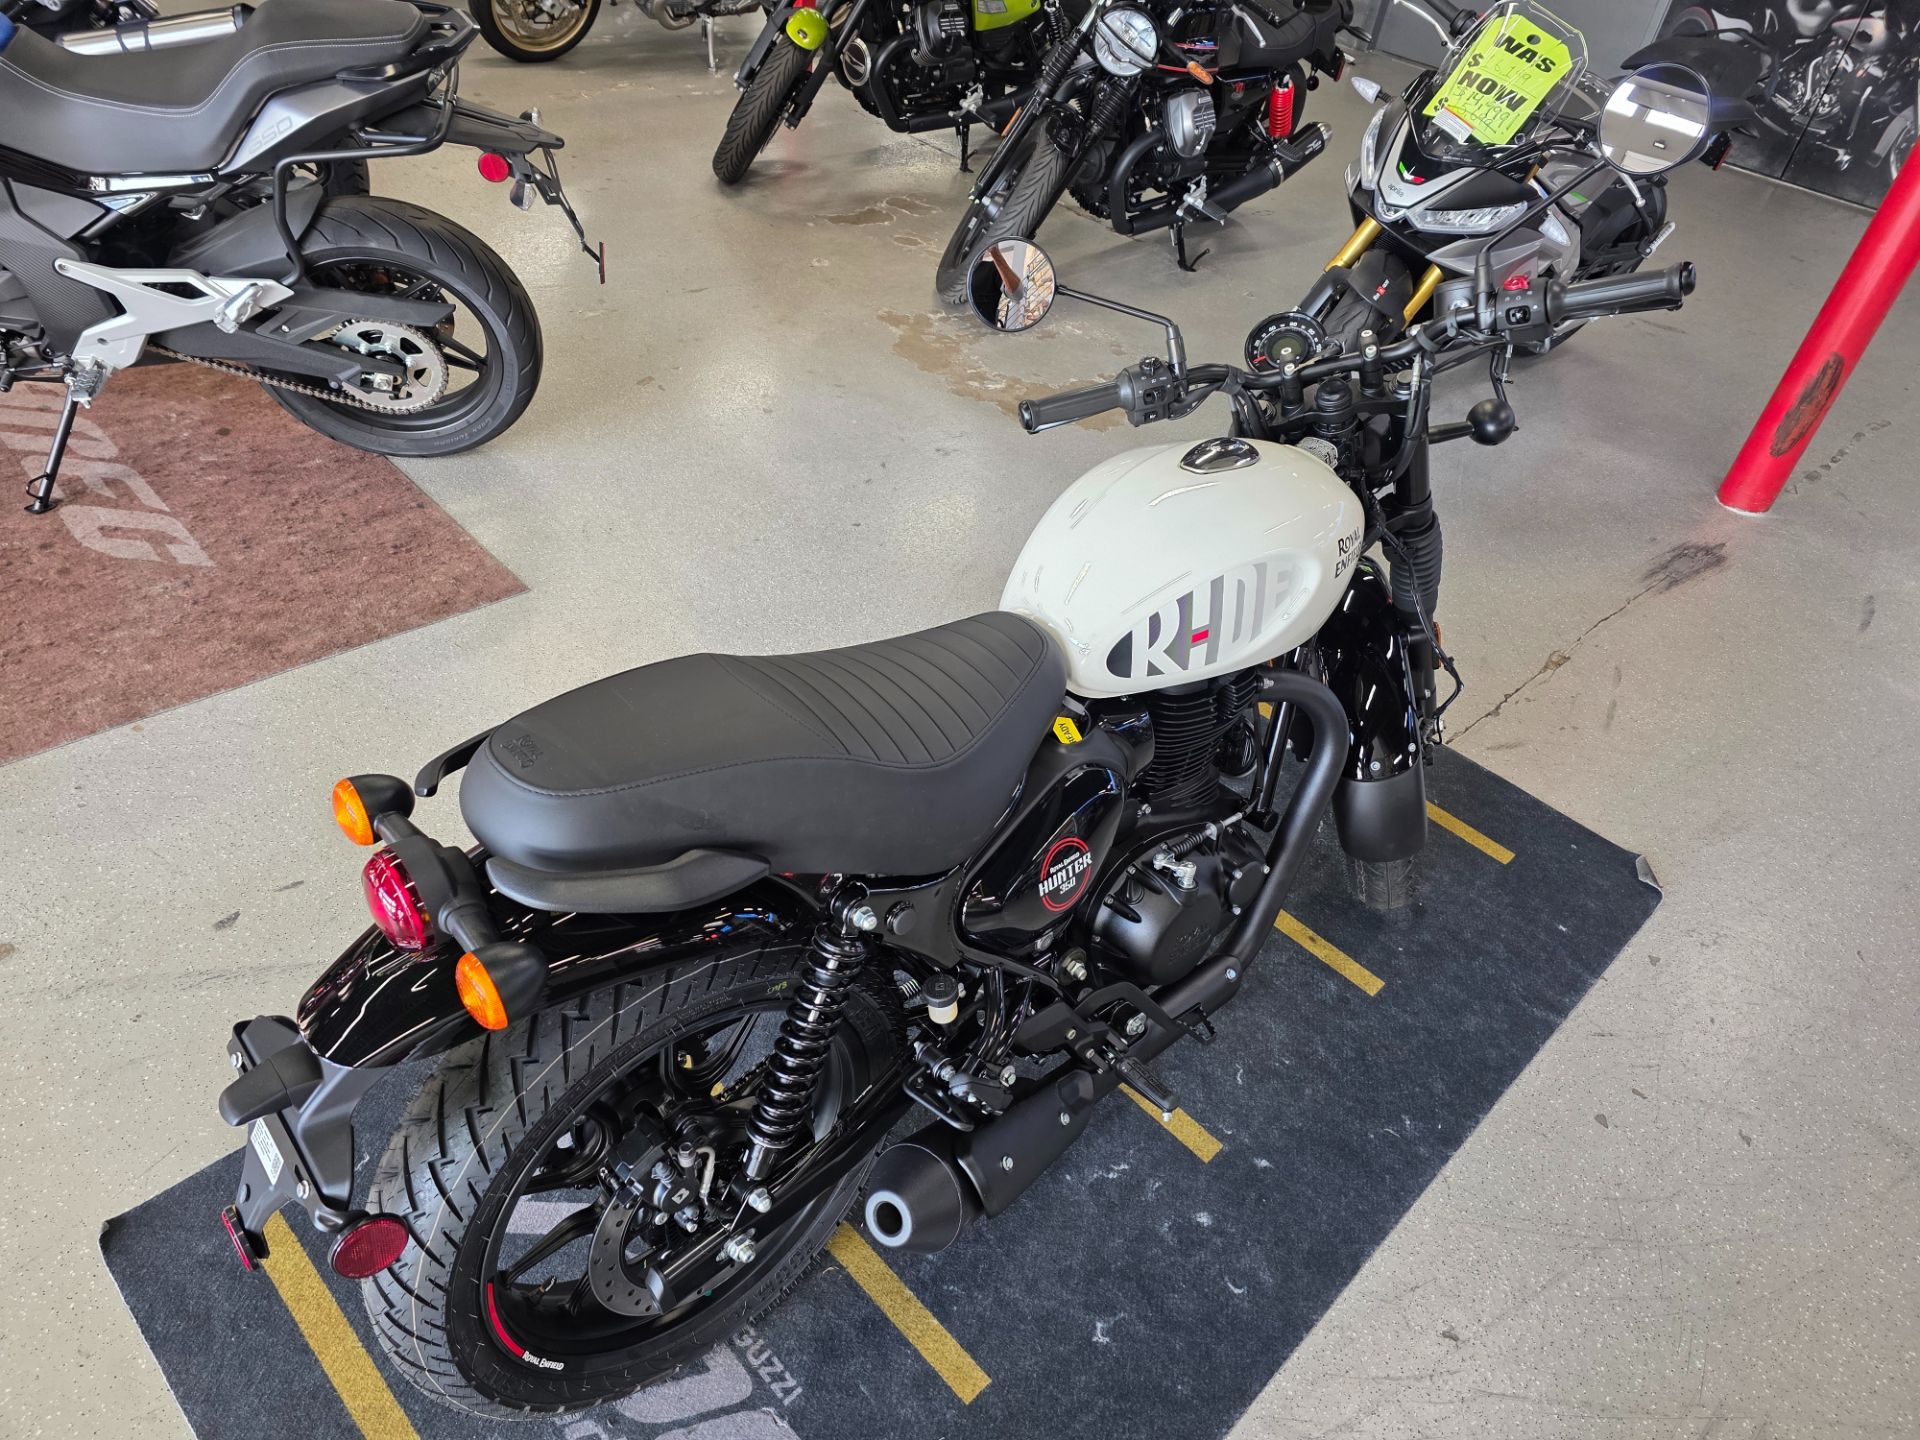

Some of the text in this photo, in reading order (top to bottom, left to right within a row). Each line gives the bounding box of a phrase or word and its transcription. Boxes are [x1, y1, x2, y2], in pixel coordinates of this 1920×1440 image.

[1468, 53, 1484, 68] $
[1494, 33, 1556, 73] WAS
[1457, 70, 1528, 112] NOW
[1038, 851, 1093, 897] HUNTER
[1059, 876, 1076, 895] 350
[521, 1350, 565, 1371] ROYAL ENFIELD
